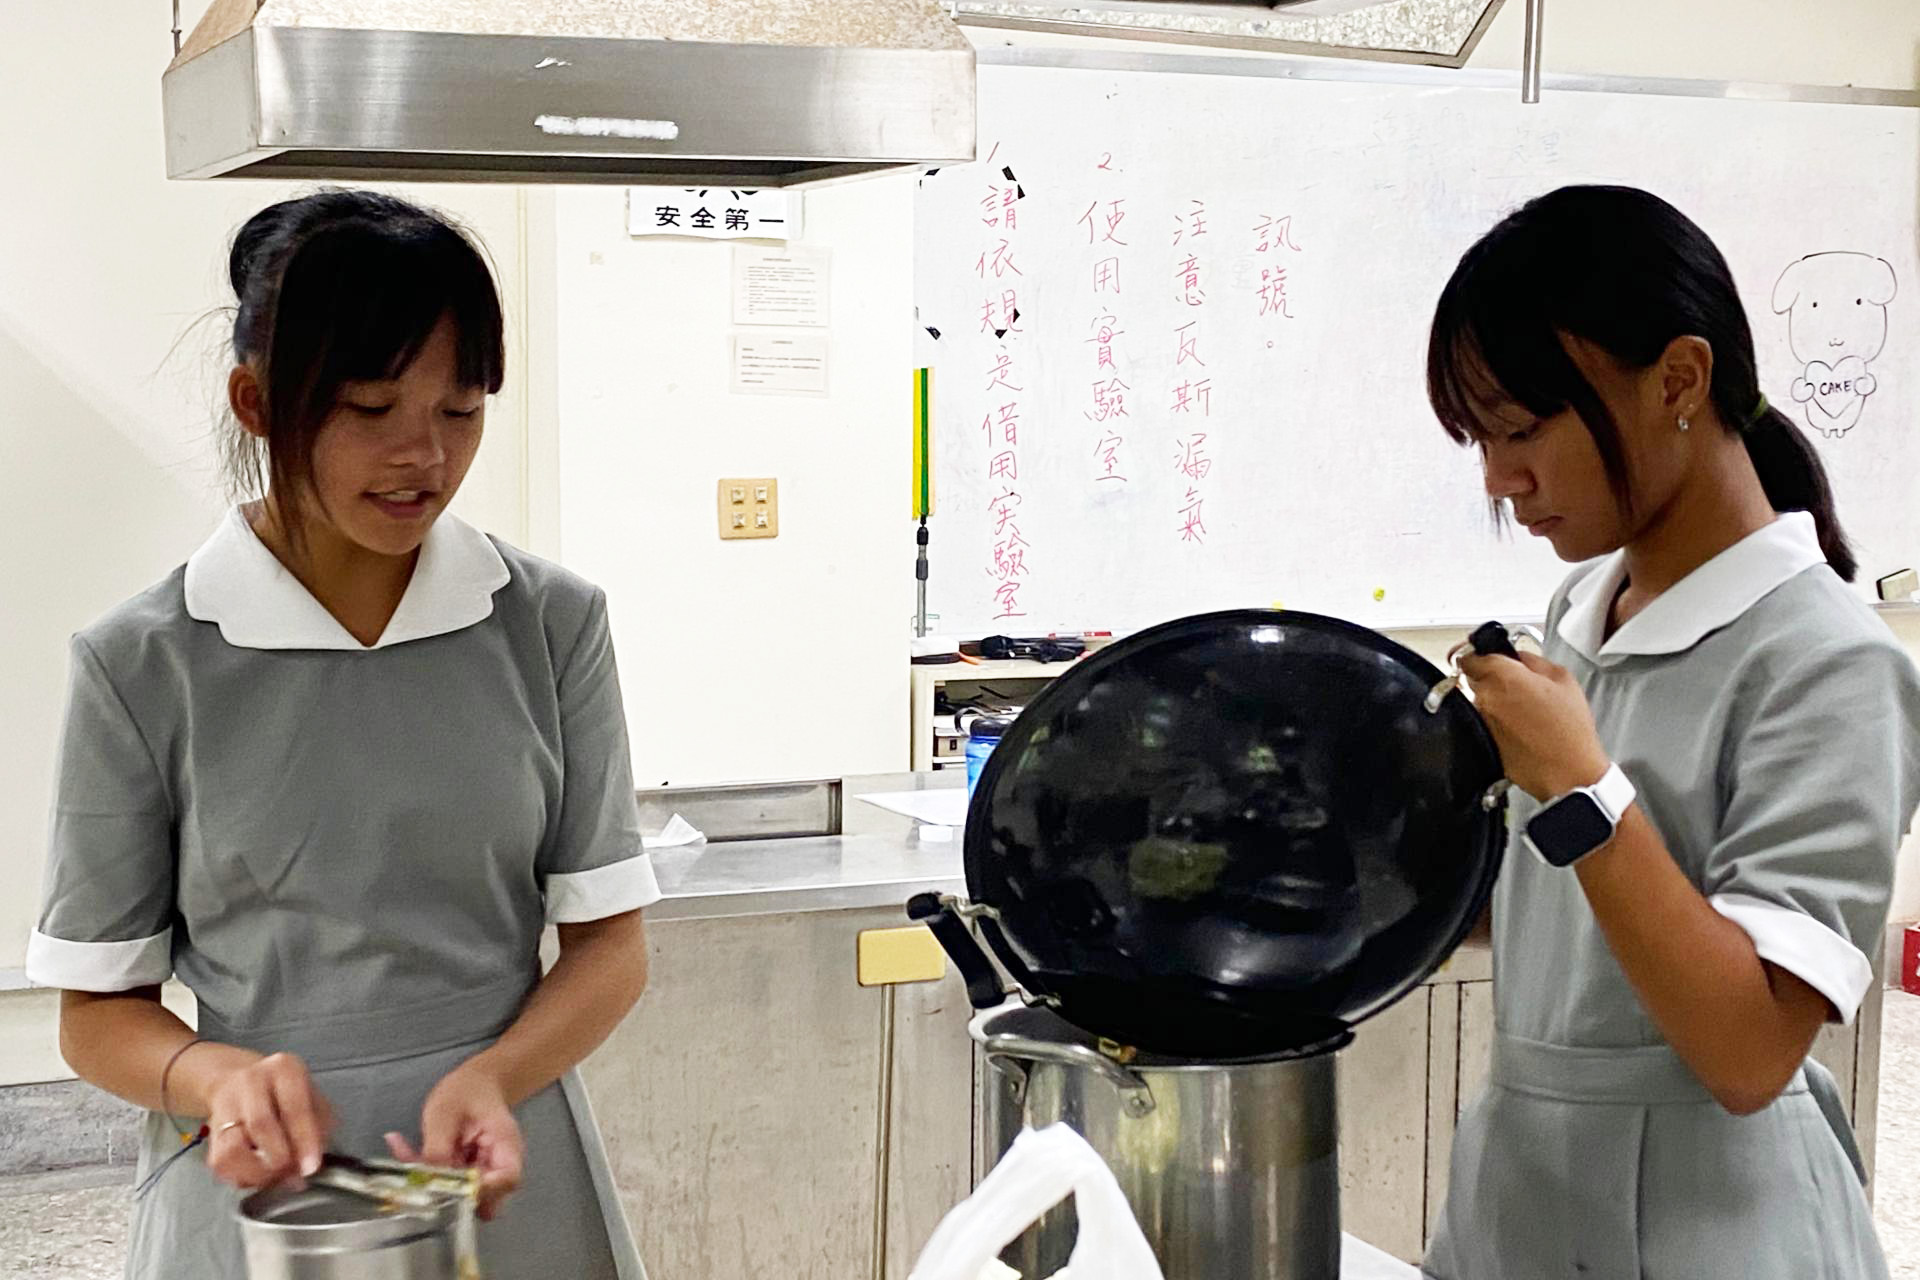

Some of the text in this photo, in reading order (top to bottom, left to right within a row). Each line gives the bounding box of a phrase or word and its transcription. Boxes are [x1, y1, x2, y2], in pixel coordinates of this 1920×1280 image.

[654, 205, 785, 231] 安全第一
[1819, 380, 1852, 396] CAKE
